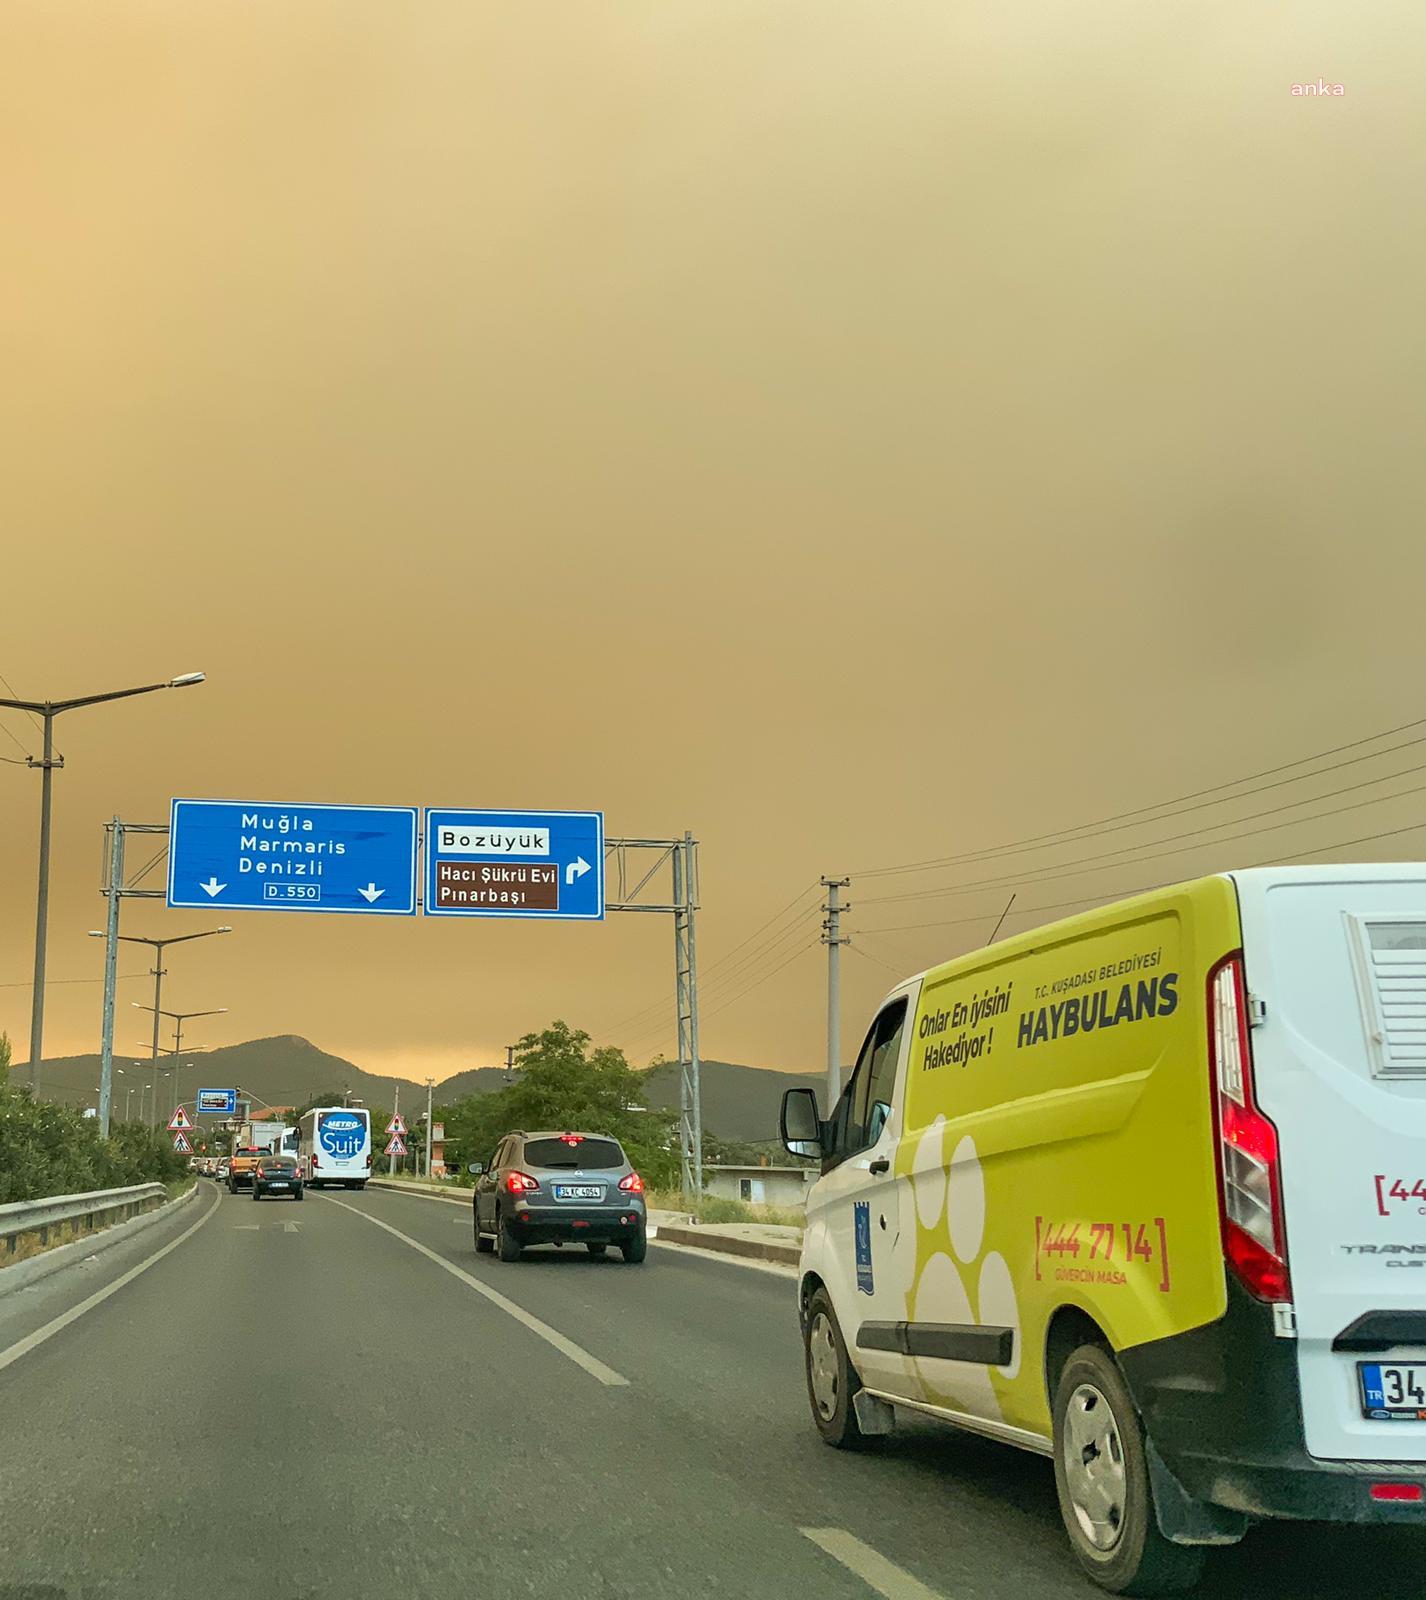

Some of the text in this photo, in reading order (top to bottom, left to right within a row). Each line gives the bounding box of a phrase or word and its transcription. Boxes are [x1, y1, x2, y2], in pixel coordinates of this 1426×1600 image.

[241, 813, 313, 834] Muğla
[240, 835, 346, 855] Marmaris
[443, 831, 544, 851] Bozüyük
[239, 857, 322, 876] Denizli
[441, 866, 555, 884] Hacı Şükrü Evi
[441, 887, 525, 905] Pınarbaşı
[1034, 947, 1162, 1000] T.C. KUŞADASI BELEDİYESİ
[919, 981, 1013, 1039] Onlar En iyisini
[1017, 972, 1179, 1049] HAYBULANS
[327, 1120, 358, 1128] METRO
[323, 1132, 362, 1154] Suit
[1096, 1271, 1128, 1286] MASA
[1366, 1369, 1425, 1405] TR 34
